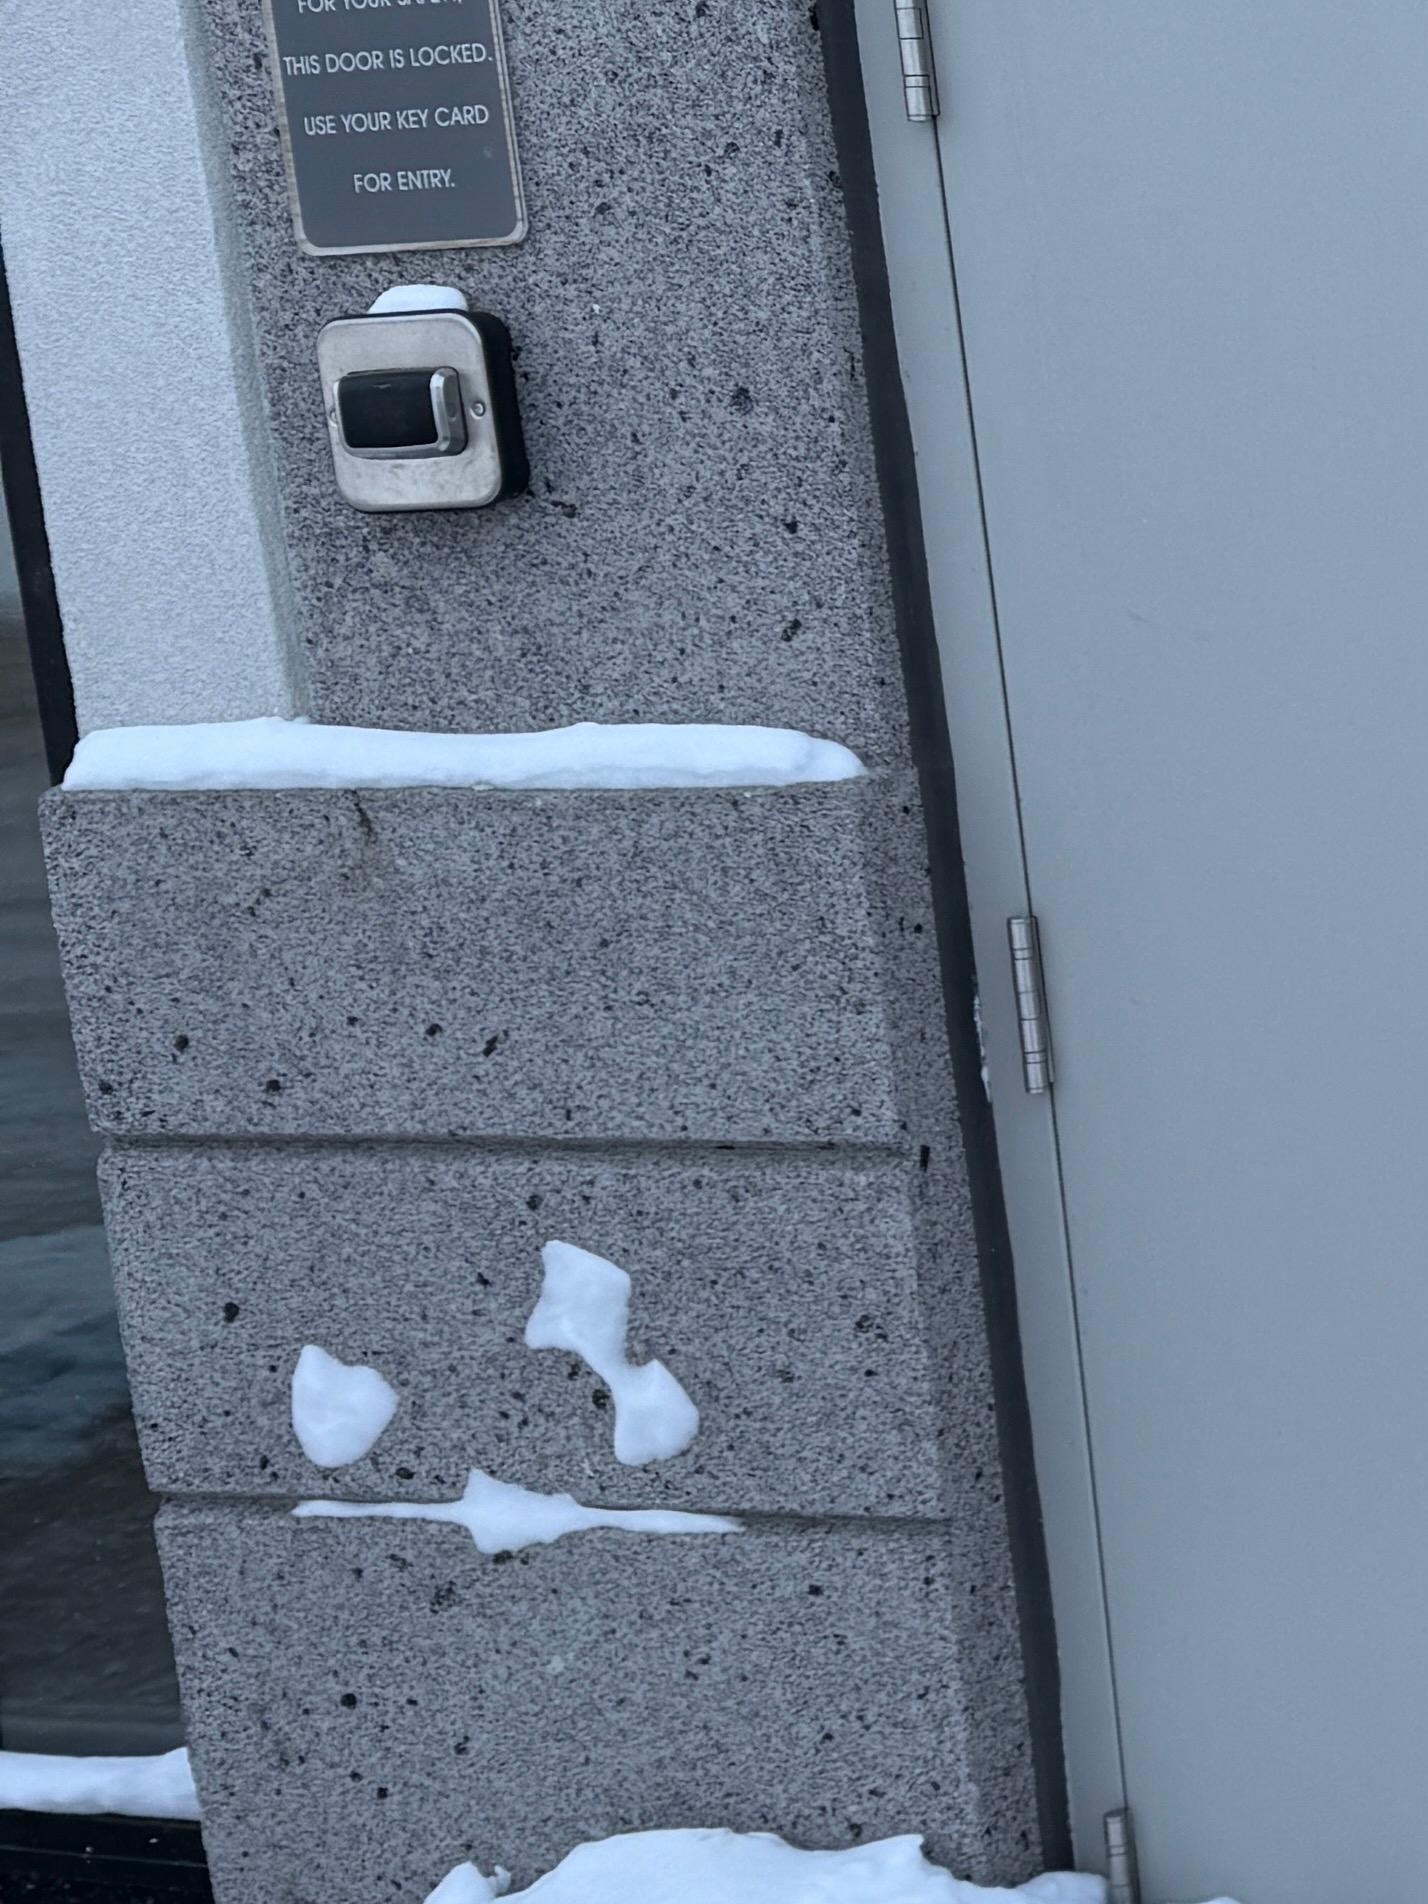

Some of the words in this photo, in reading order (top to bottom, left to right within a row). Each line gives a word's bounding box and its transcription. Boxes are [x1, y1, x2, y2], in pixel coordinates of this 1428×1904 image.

[283, 55, 321, 75] THIS
[325, 51, 384, 72] DOOR
[389, 48, 405, 69] IS
[410, 43, 493, 67] LOCKED.
[304, 115, 337, 135] USE
[340, 111, 392, 133] YOUR
[396, 109, 429, 129] KEY
[434, 104, 489, 127] CARD
[353, 172, 392, 193] FOR
[397, 168, 456, 190] ENTRY.
